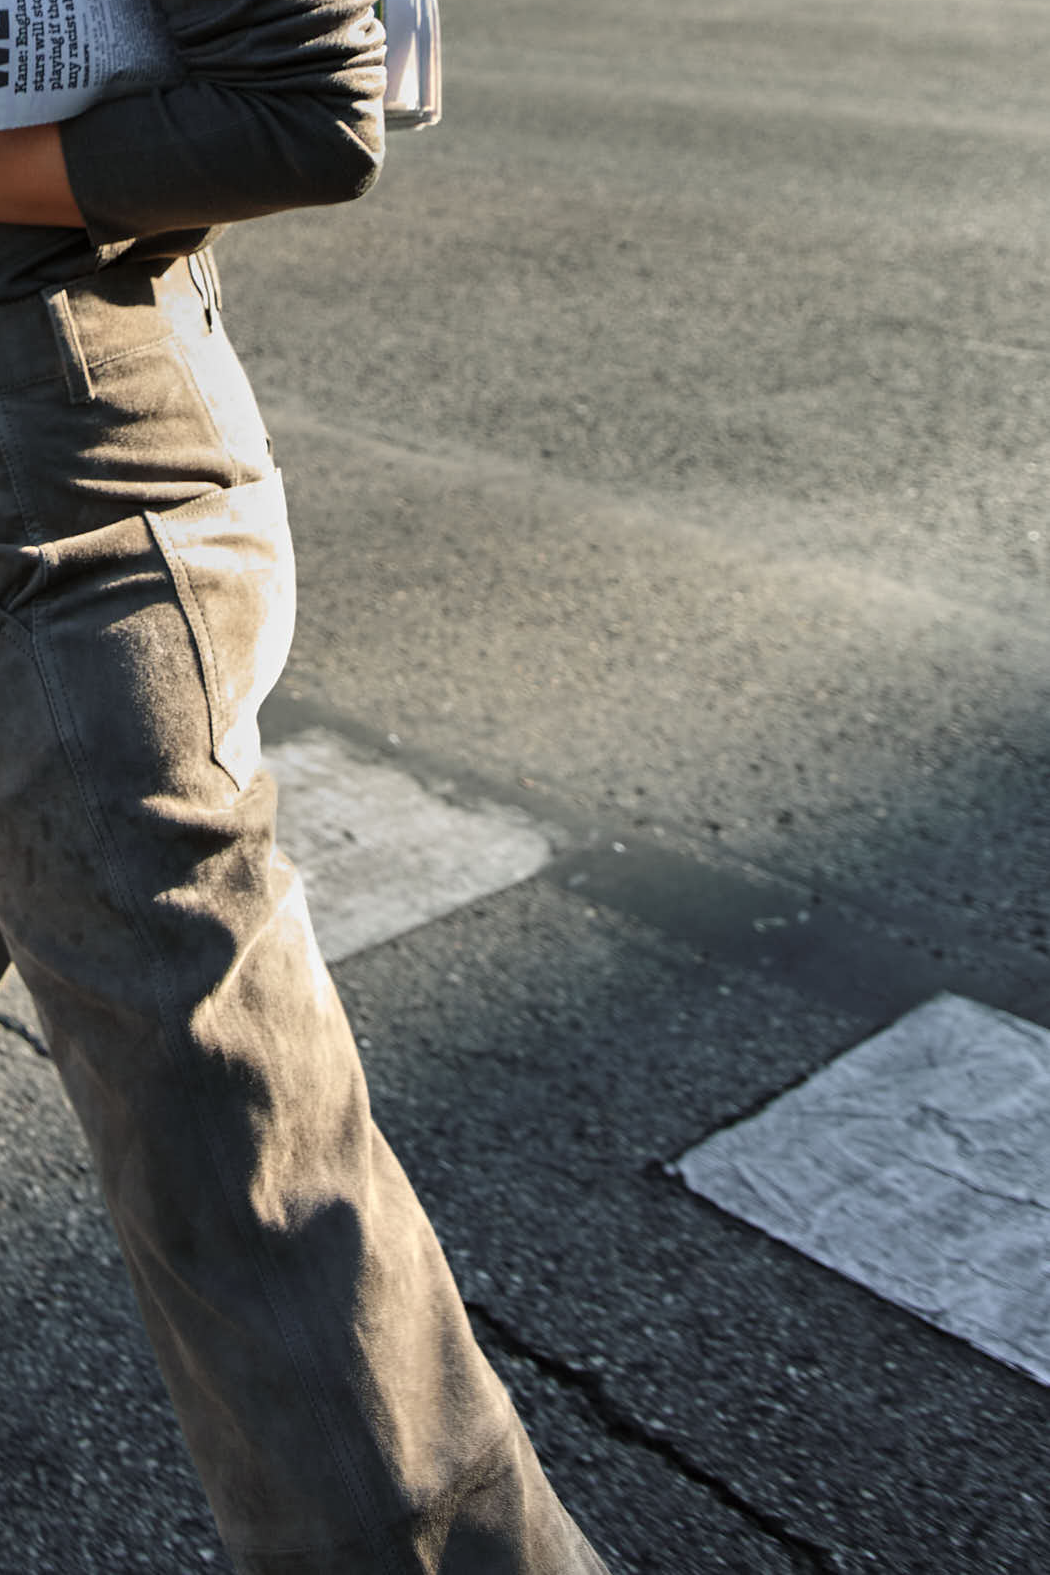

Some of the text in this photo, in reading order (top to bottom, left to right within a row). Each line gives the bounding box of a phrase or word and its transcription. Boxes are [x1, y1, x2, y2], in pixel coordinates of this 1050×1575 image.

[32, 22, 44, 51] will
[50, 23, 61, 34] if
[65, 15, 78, 58] racist
[14, 50, 28, 94] Kane:
[33, 54, 45, 92] stars
[49, 37, 65, 91] playing
[67, 62, 81, 89] any
